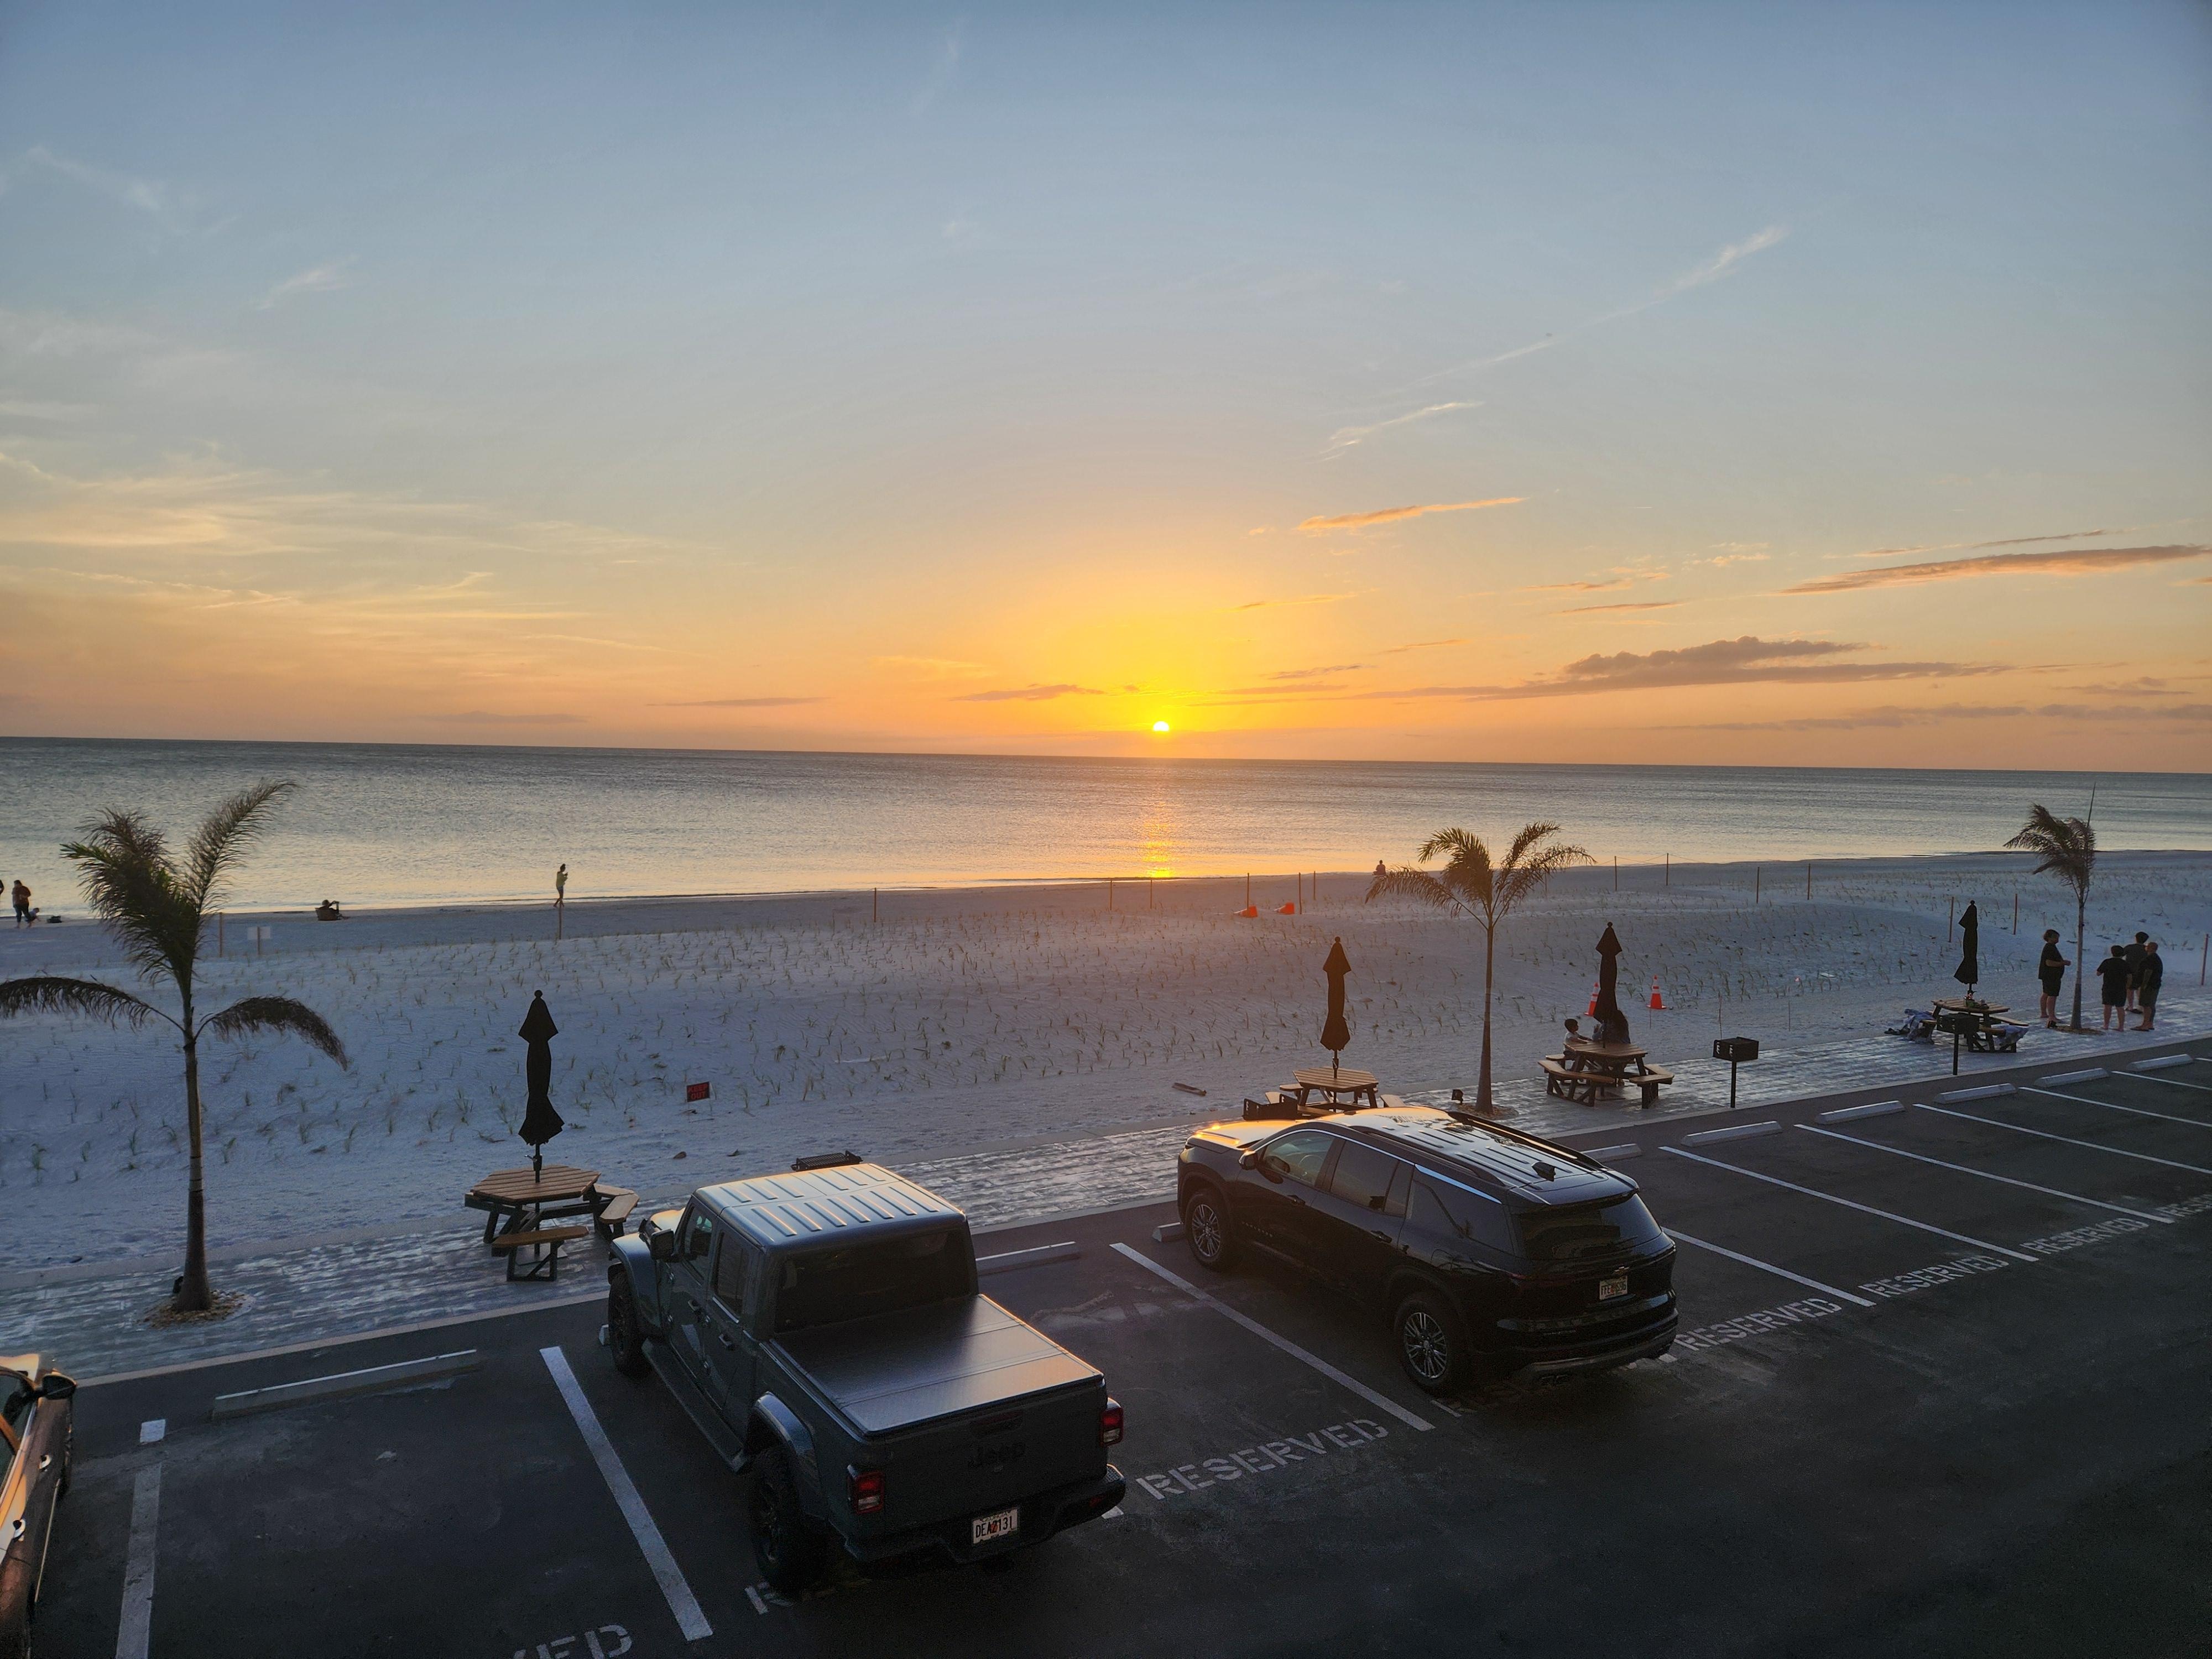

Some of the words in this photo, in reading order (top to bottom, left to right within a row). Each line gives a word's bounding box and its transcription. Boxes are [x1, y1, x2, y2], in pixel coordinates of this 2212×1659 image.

[688, 1083, 708, 1093] KEEP
[690, 1091, 706, 1100] OUT
[2019, 1218, 2150, 1254] RESERVED
[1858, 1255, 2009, 1298] RESERVED
[1673, 1298, 1842, 1351] RESERVED
[1136, 1419, 1389, 1500] RESERVED
